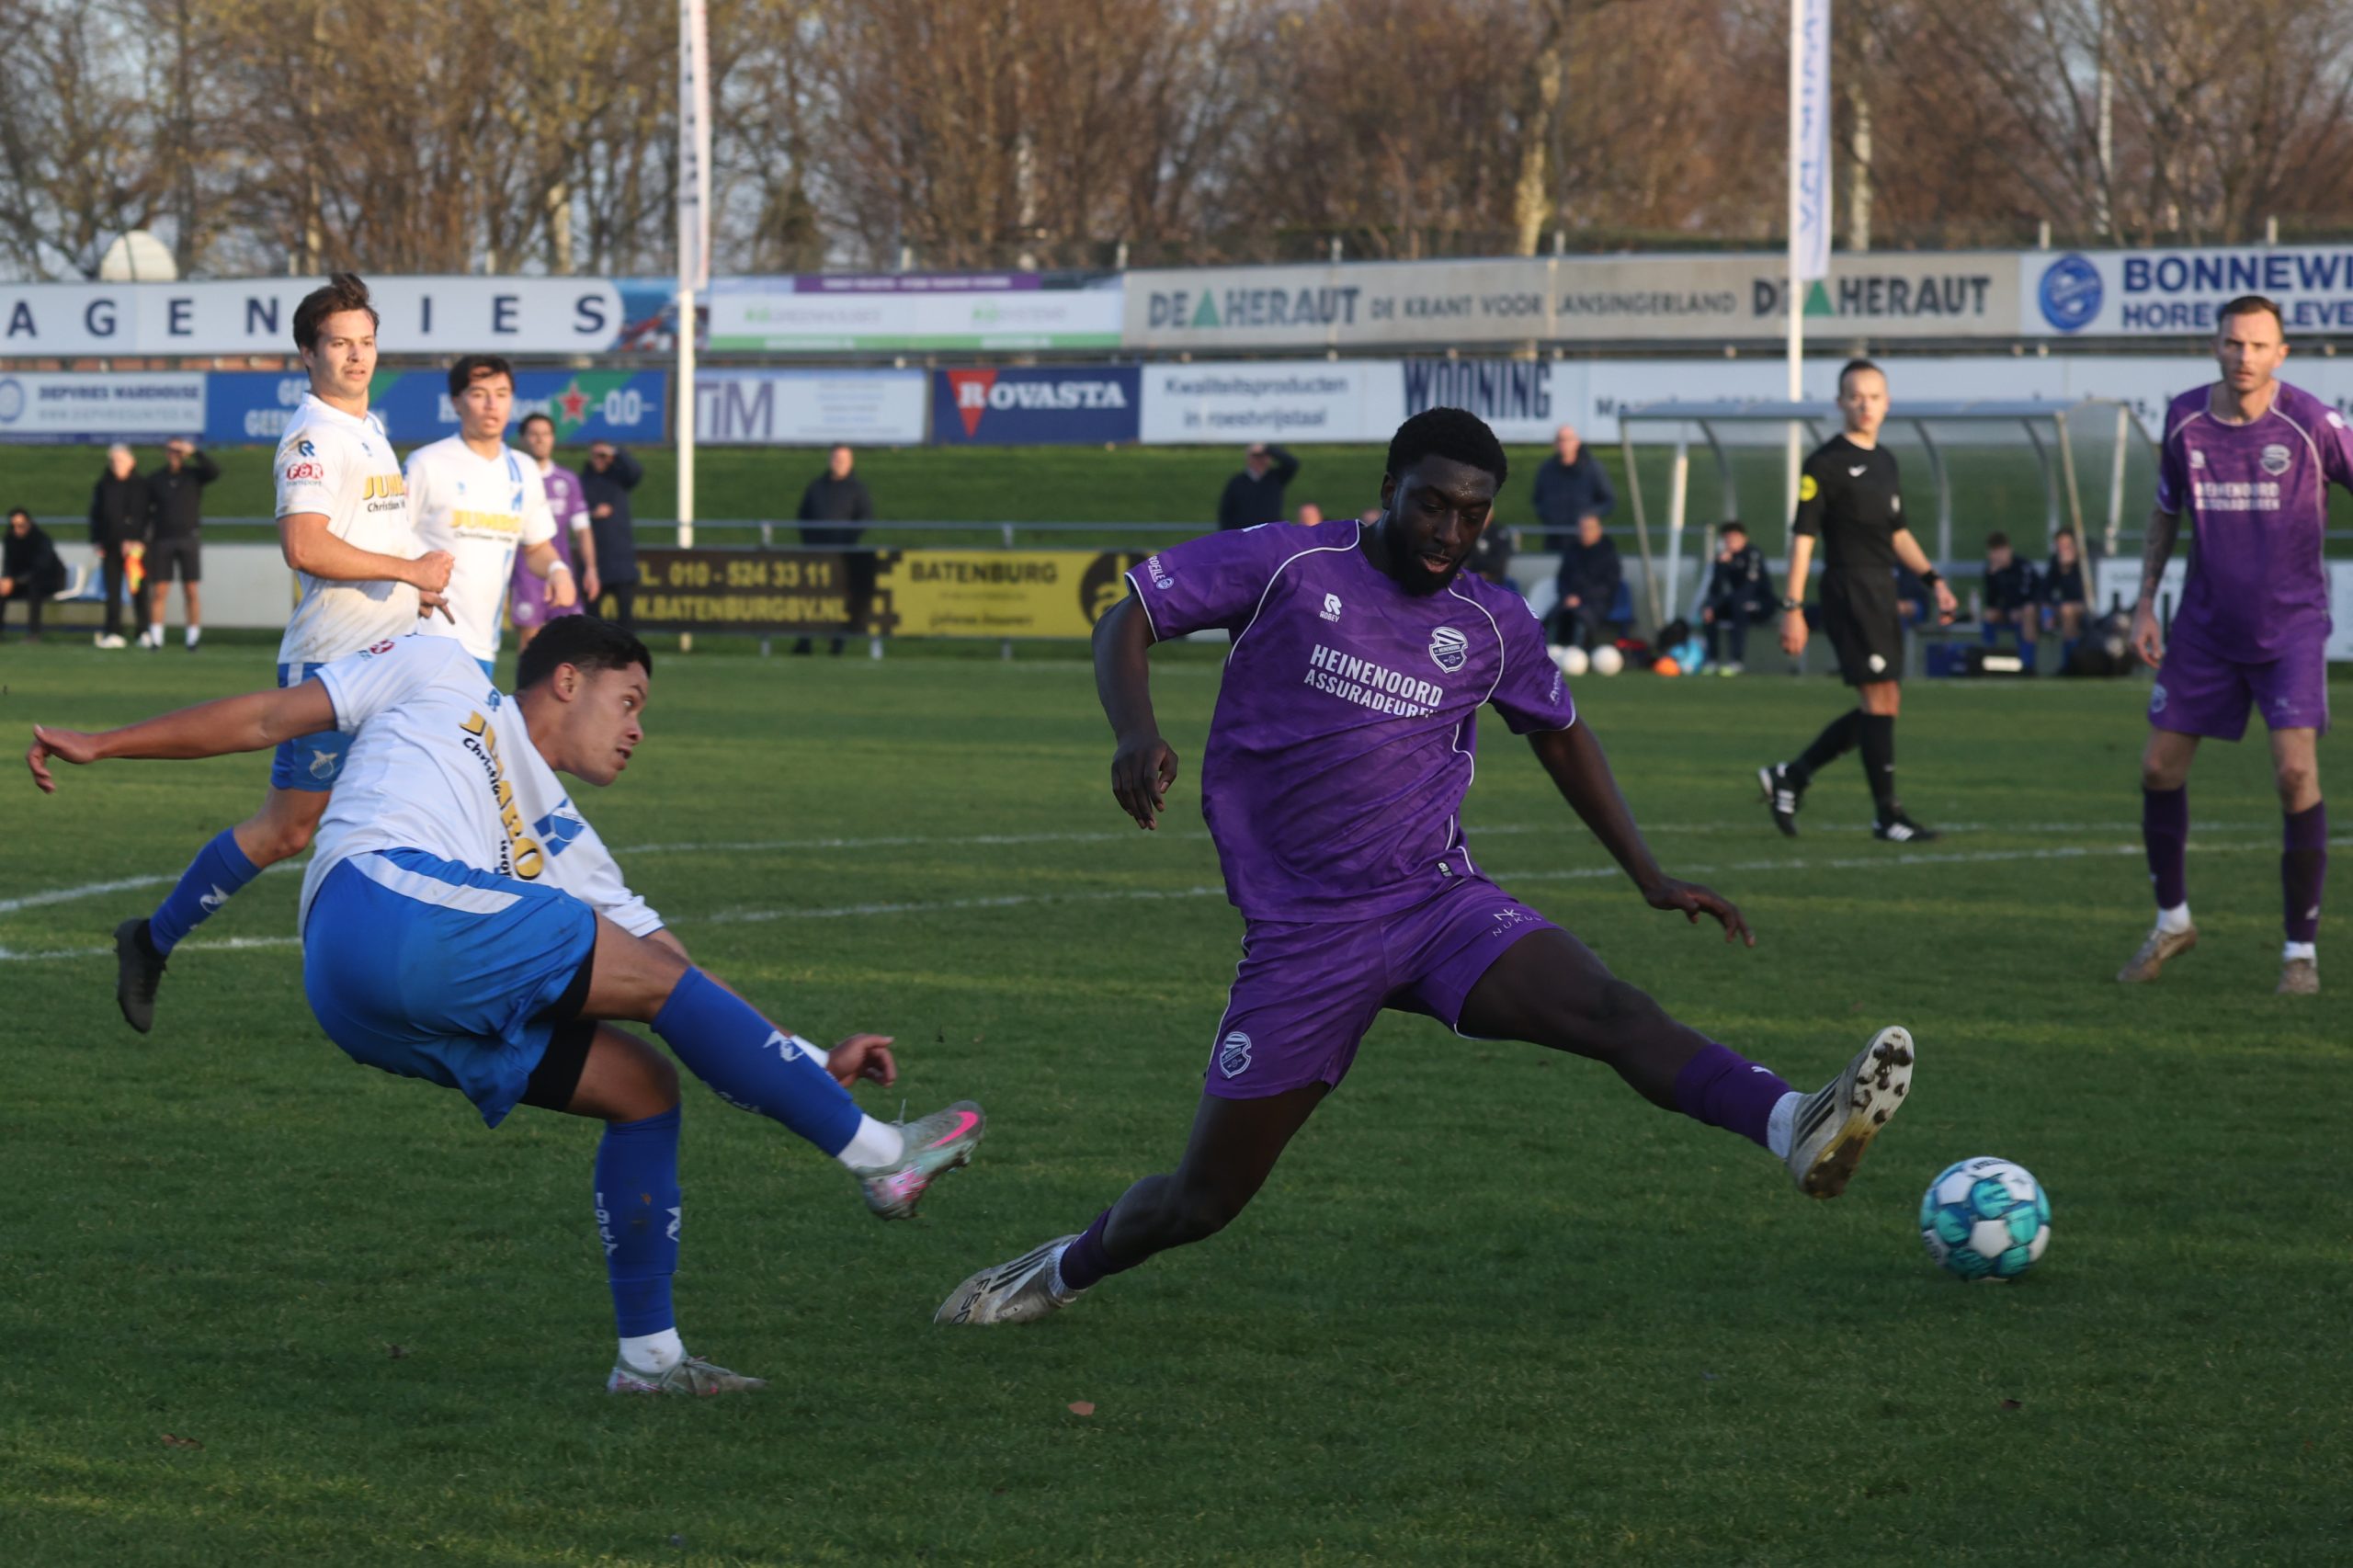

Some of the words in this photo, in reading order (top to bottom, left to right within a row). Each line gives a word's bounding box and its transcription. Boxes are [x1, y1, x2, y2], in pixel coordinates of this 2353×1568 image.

[1149, 291, 1188, 327] DE
[1225, 287, 1359, 324] HERAUT
[1479, 293, 1543, 315] VOOR
[1839, 277, 1992, 315] HERAUT
[957, 381, 1126, 410] ROVASTA
[1164, 373, 1349, 398] Kwaliteitsproducten
[669, 561, 710, 587] 010
[910, 561, 1057, 585] BATENBURG
[1319, 610, 1340, 623] ROBEY
[1309, 643, 1443, 708] HEINENOORD
[1304, 668, 1438, 719] ASSURADEURE
